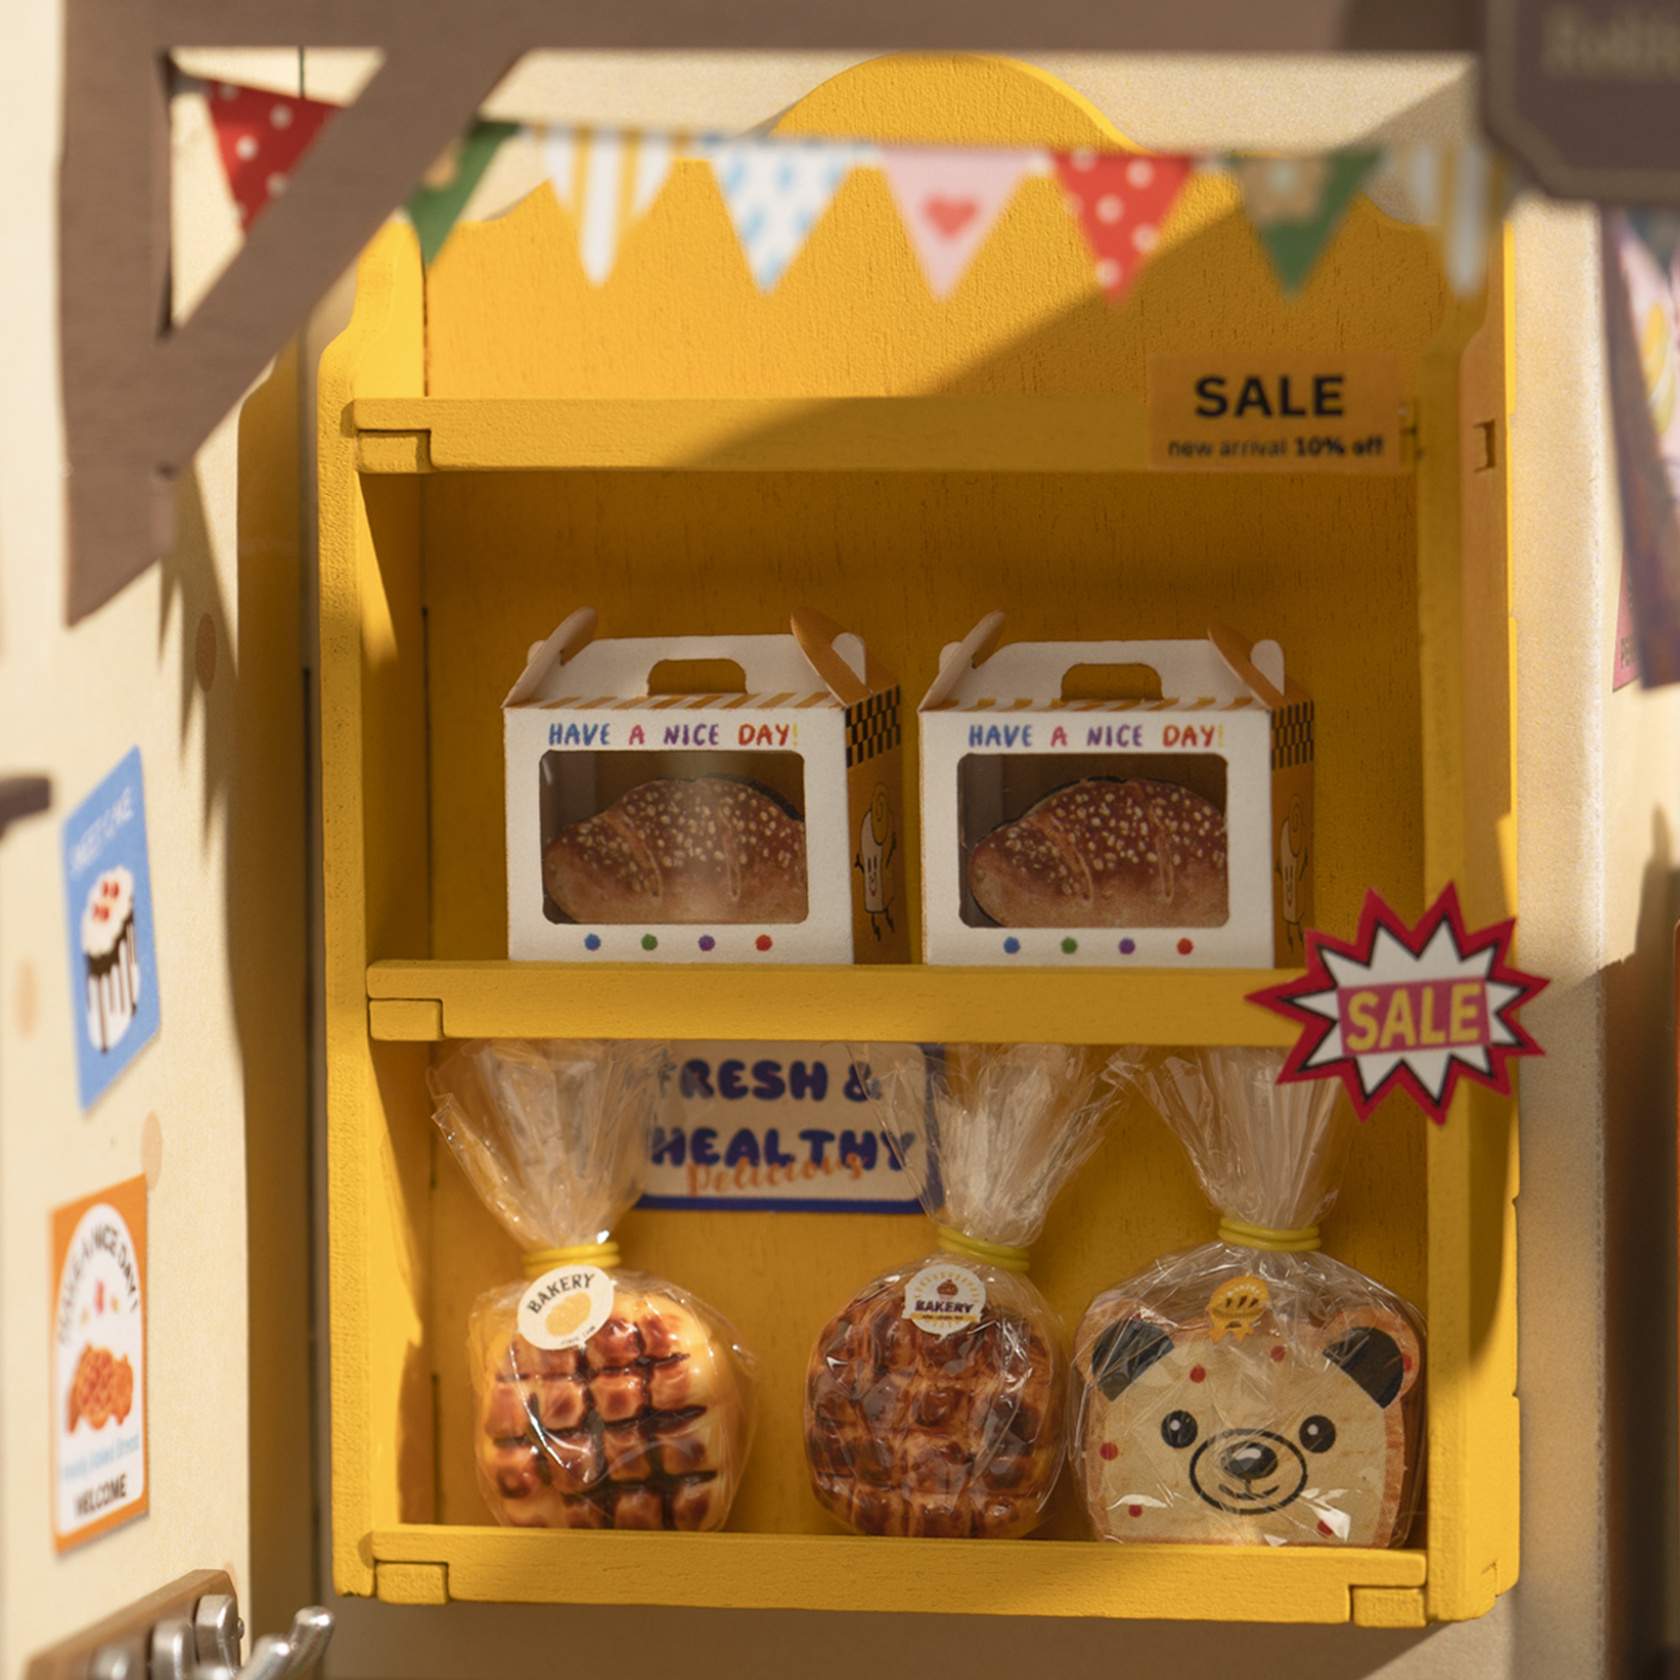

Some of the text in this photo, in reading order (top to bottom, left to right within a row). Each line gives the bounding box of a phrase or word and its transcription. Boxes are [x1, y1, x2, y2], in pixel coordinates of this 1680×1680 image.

[1194, 375, 1346, 418] SALE
[1168, 434, 1384, 458] new arrival 10% off
[548, 722, 798, 746] HAVE A NICE DAY!
[968, 723, 1225, 748] HAVE A NICE DAY!
[1346, 983, 1482, 1052] SALE
[844, 1061, 884, 1102] &
[651, 1126, 916, 1171] HEALTHY
[527, 1272, 595, 1315] BAKERY
[915, 1299, 974, 1314] BAKERY
[74, 1473, 127, 1517] WELCOME
